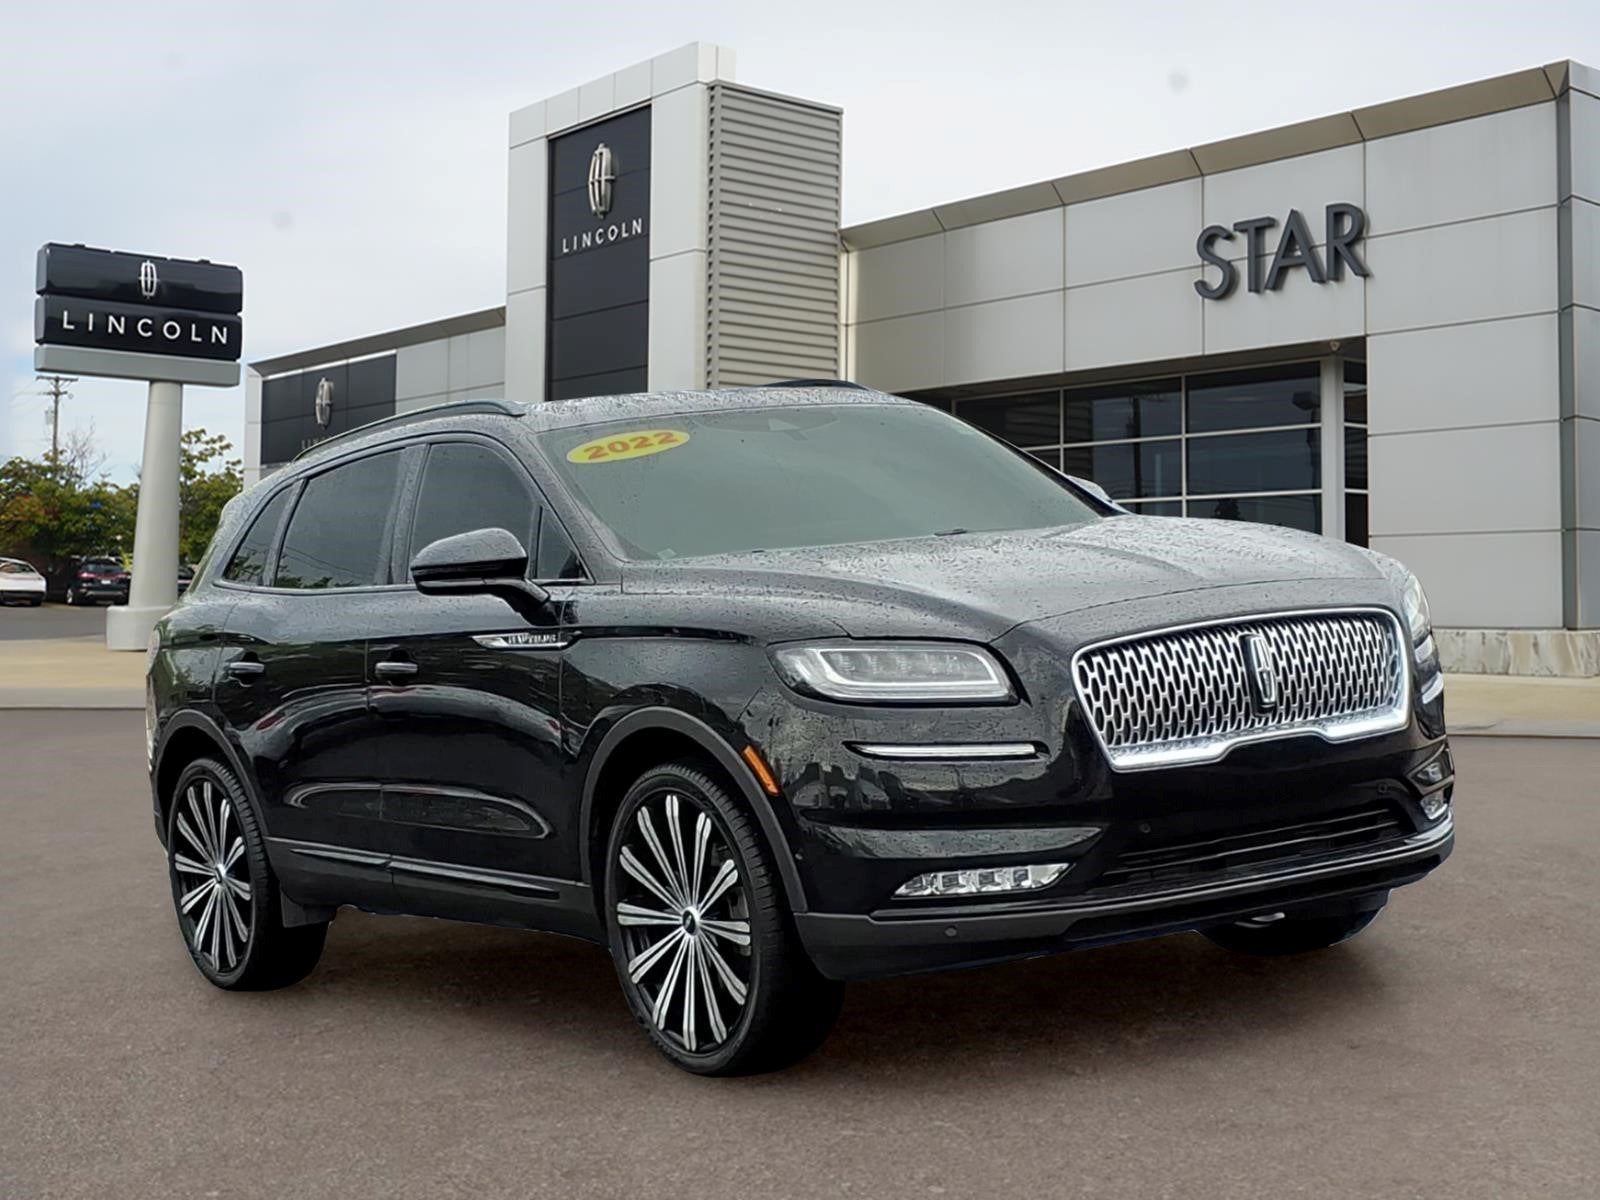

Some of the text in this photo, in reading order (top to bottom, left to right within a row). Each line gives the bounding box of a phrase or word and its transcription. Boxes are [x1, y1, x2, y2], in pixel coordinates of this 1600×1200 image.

[562, 217, 642, 253] LINCOLN
[1194, 202, 1371, 300] STAR
[62, 310, 228, 345] LINCOLN
[583, 431, 679, 460] 2022
